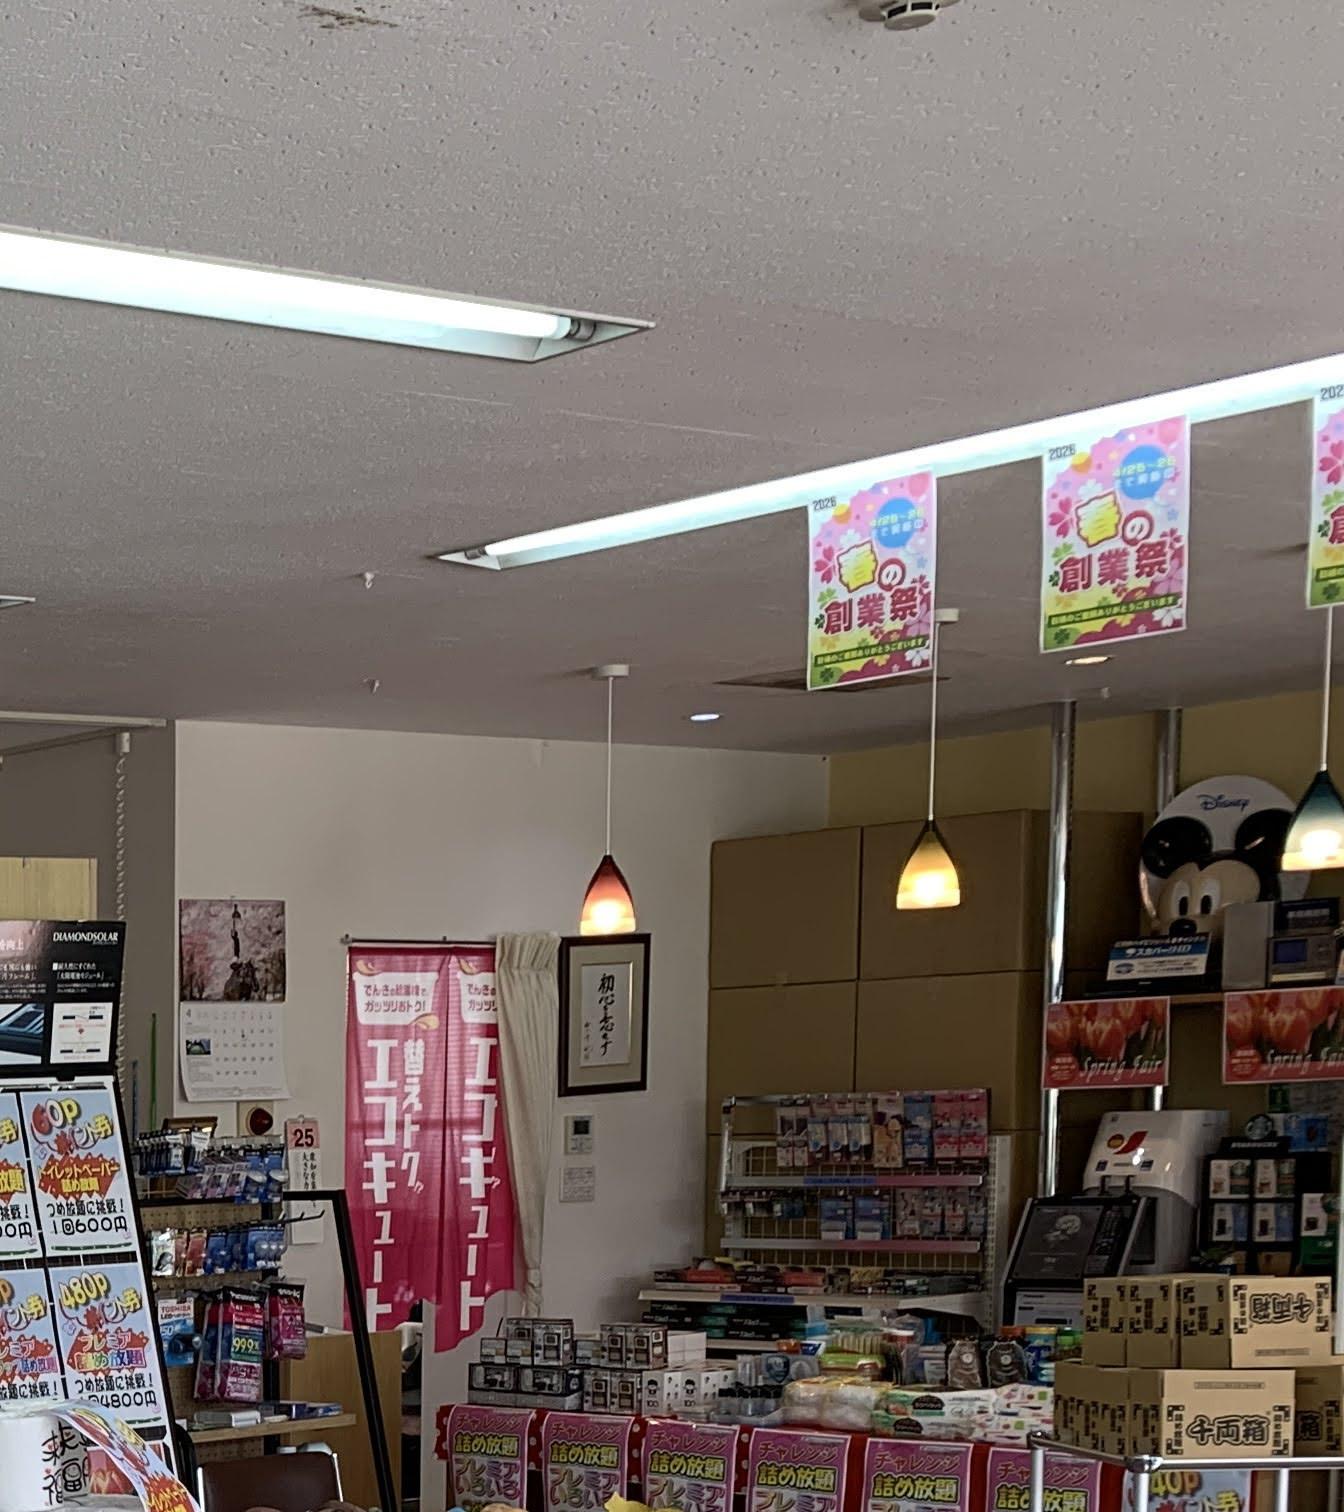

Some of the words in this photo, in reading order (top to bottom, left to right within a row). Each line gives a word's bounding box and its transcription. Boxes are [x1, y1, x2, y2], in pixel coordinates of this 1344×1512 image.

[1048, 444, 1076, 461] 2026
[1059, 541, 1170, 593] 創業祭
[823, 588, 920, 635] 創業祭
[52, 930, 119, 943] DIAMONDSOLAR
[292, 1128, 315, 1147] 25
[1186, 1415, 1270, 1445] 千両箱
[454, 1431, 519, 1458] 詰め放題
